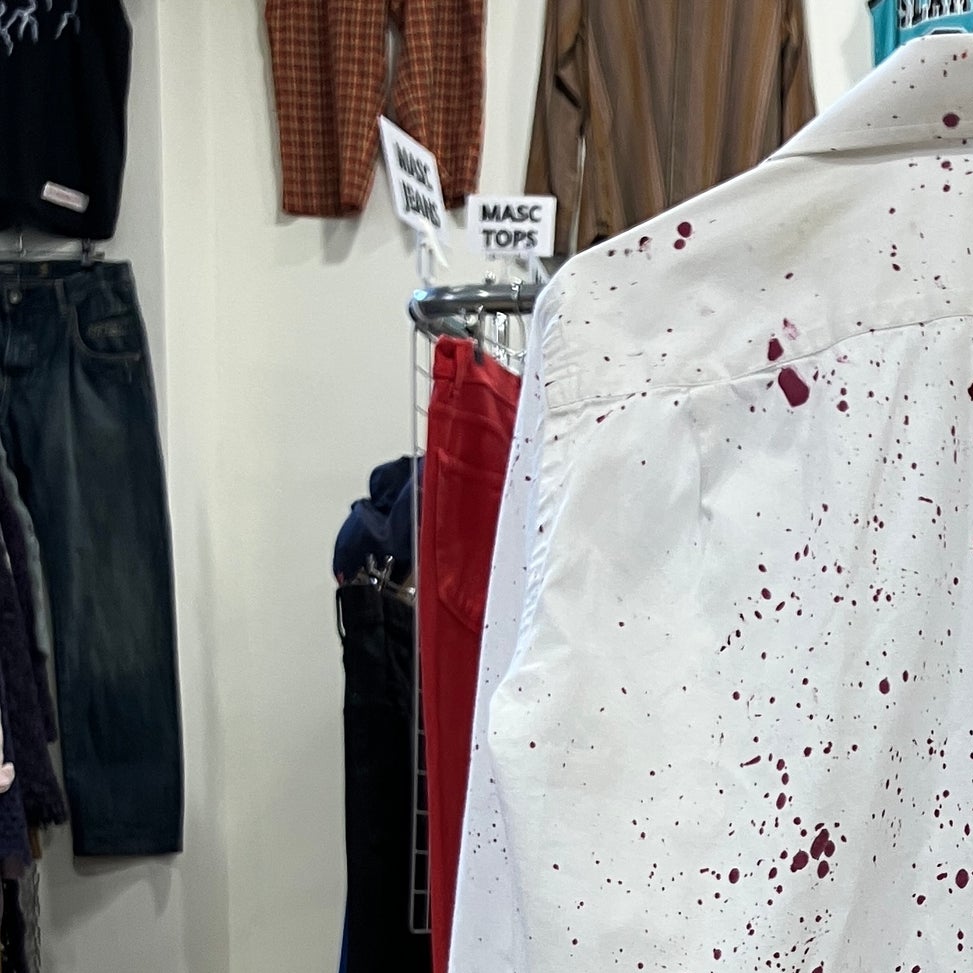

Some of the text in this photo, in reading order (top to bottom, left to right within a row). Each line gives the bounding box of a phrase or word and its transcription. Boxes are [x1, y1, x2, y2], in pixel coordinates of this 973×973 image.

[394, 141, 434, 192] MASC
[401, 180, 441, 229] JEANS
[481, 203, 543, 223] MASC
[482, 229, 539, 249] TOPS
